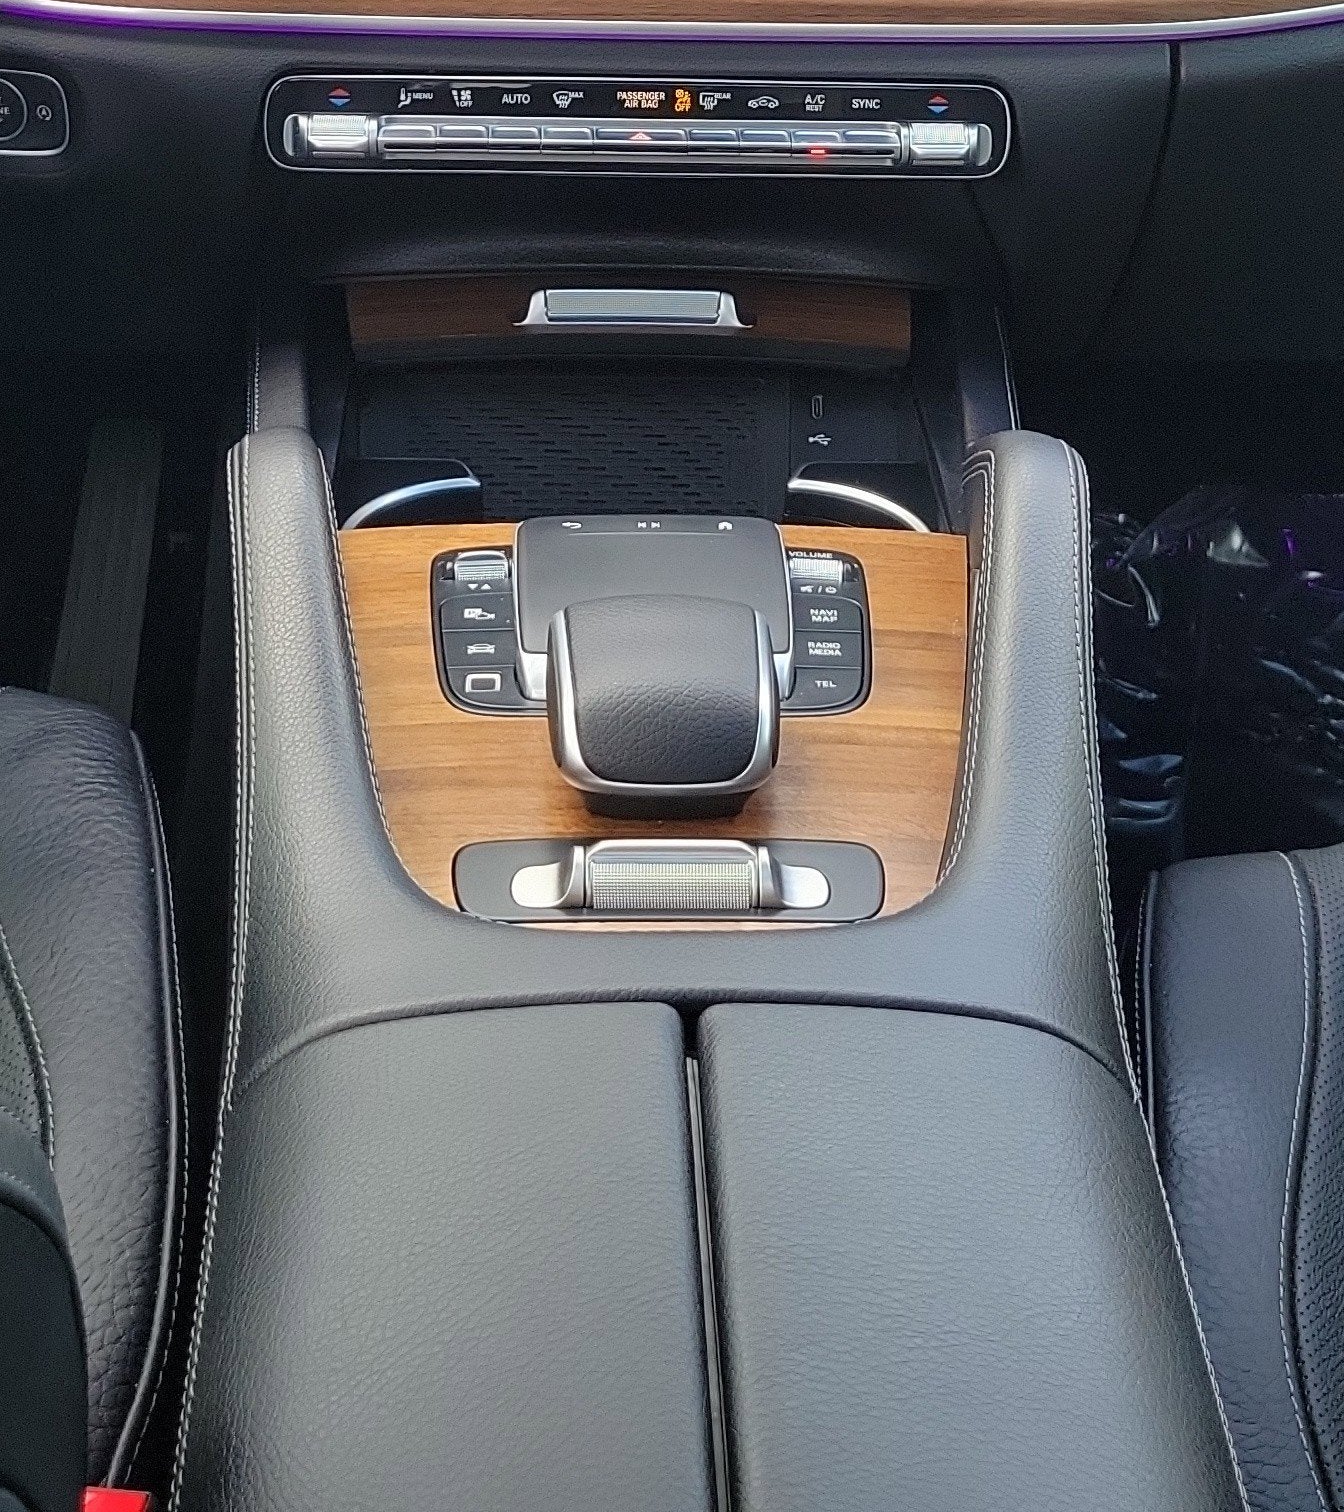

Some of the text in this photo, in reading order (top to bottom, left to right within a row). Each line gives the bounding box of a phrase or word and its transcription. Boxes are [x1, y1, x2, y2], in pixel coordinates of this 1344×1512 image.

[502, 93, 531, 105] AUTO
[568, 91, 584, 99] MAX
[617, 91, 666, 100] PASSENGER
[805, 94, 826, 104] A/C
[624, 100, 659, 108] AIR BAG
[675, 104, 691, 112] OFF
[851, 99, 881, 109] SYNC
[788, 550, 833, 559] VOLUME
[811, 615, 838, 623] MAP
[807, 641, 841, 649] RADIO
[808, 648, 842, 657] MEDIA
[815, 679, 837, 688] TEL
